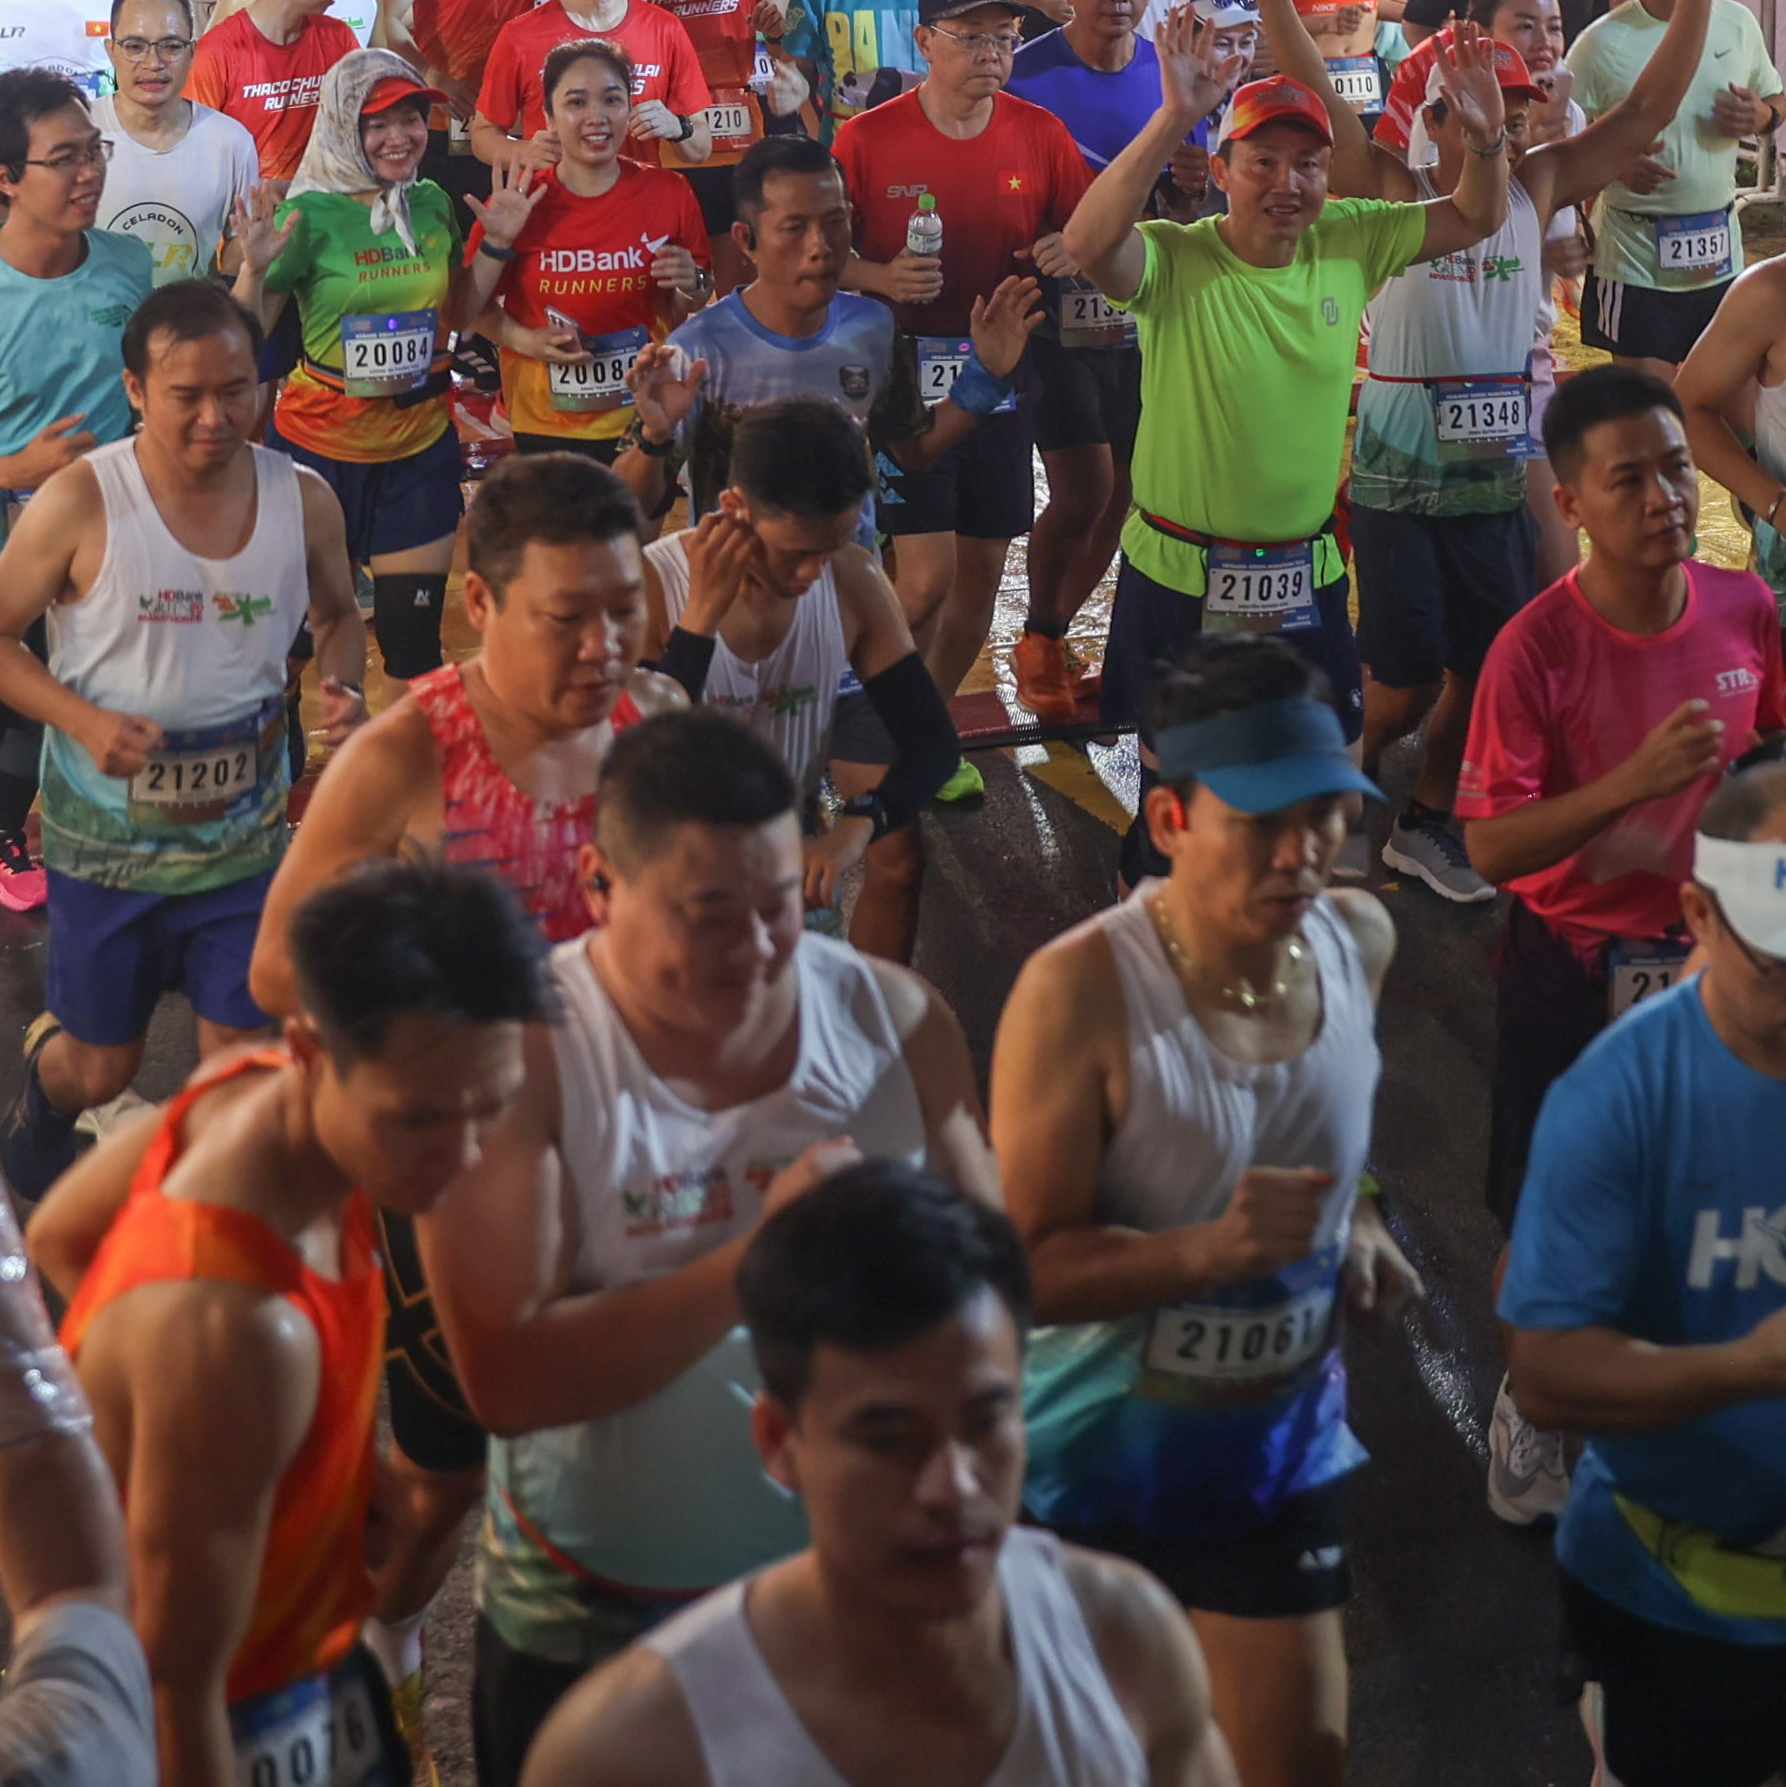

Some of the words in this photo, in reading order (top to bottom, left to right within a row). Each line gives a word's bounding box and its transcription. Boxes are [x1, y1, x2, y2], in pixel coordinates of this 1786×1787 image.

[1312, 2, 1337, 12] NIKE
[241, 81, 290, 100] THACO
[263, 89, 323, 112] RUNNER
[122, 212, 184, 236] CELADON
[353, 240, 426, 268] HDBank
[538, 245, 644, 274] HDBank
[1670, 232, 1725, 260] 21357
[357, 262, 433, 284] RUNNERS
[538, 274, 648, 296] RUNNERS
[354, 335, 429, 368] 20084
[1448, 398, 1521, 430] 21348
[1220, 570, 1304, 602] 21039
[147, 752, 248, 791] 21202
[1176, 1314, 1317, 1363] 21061
